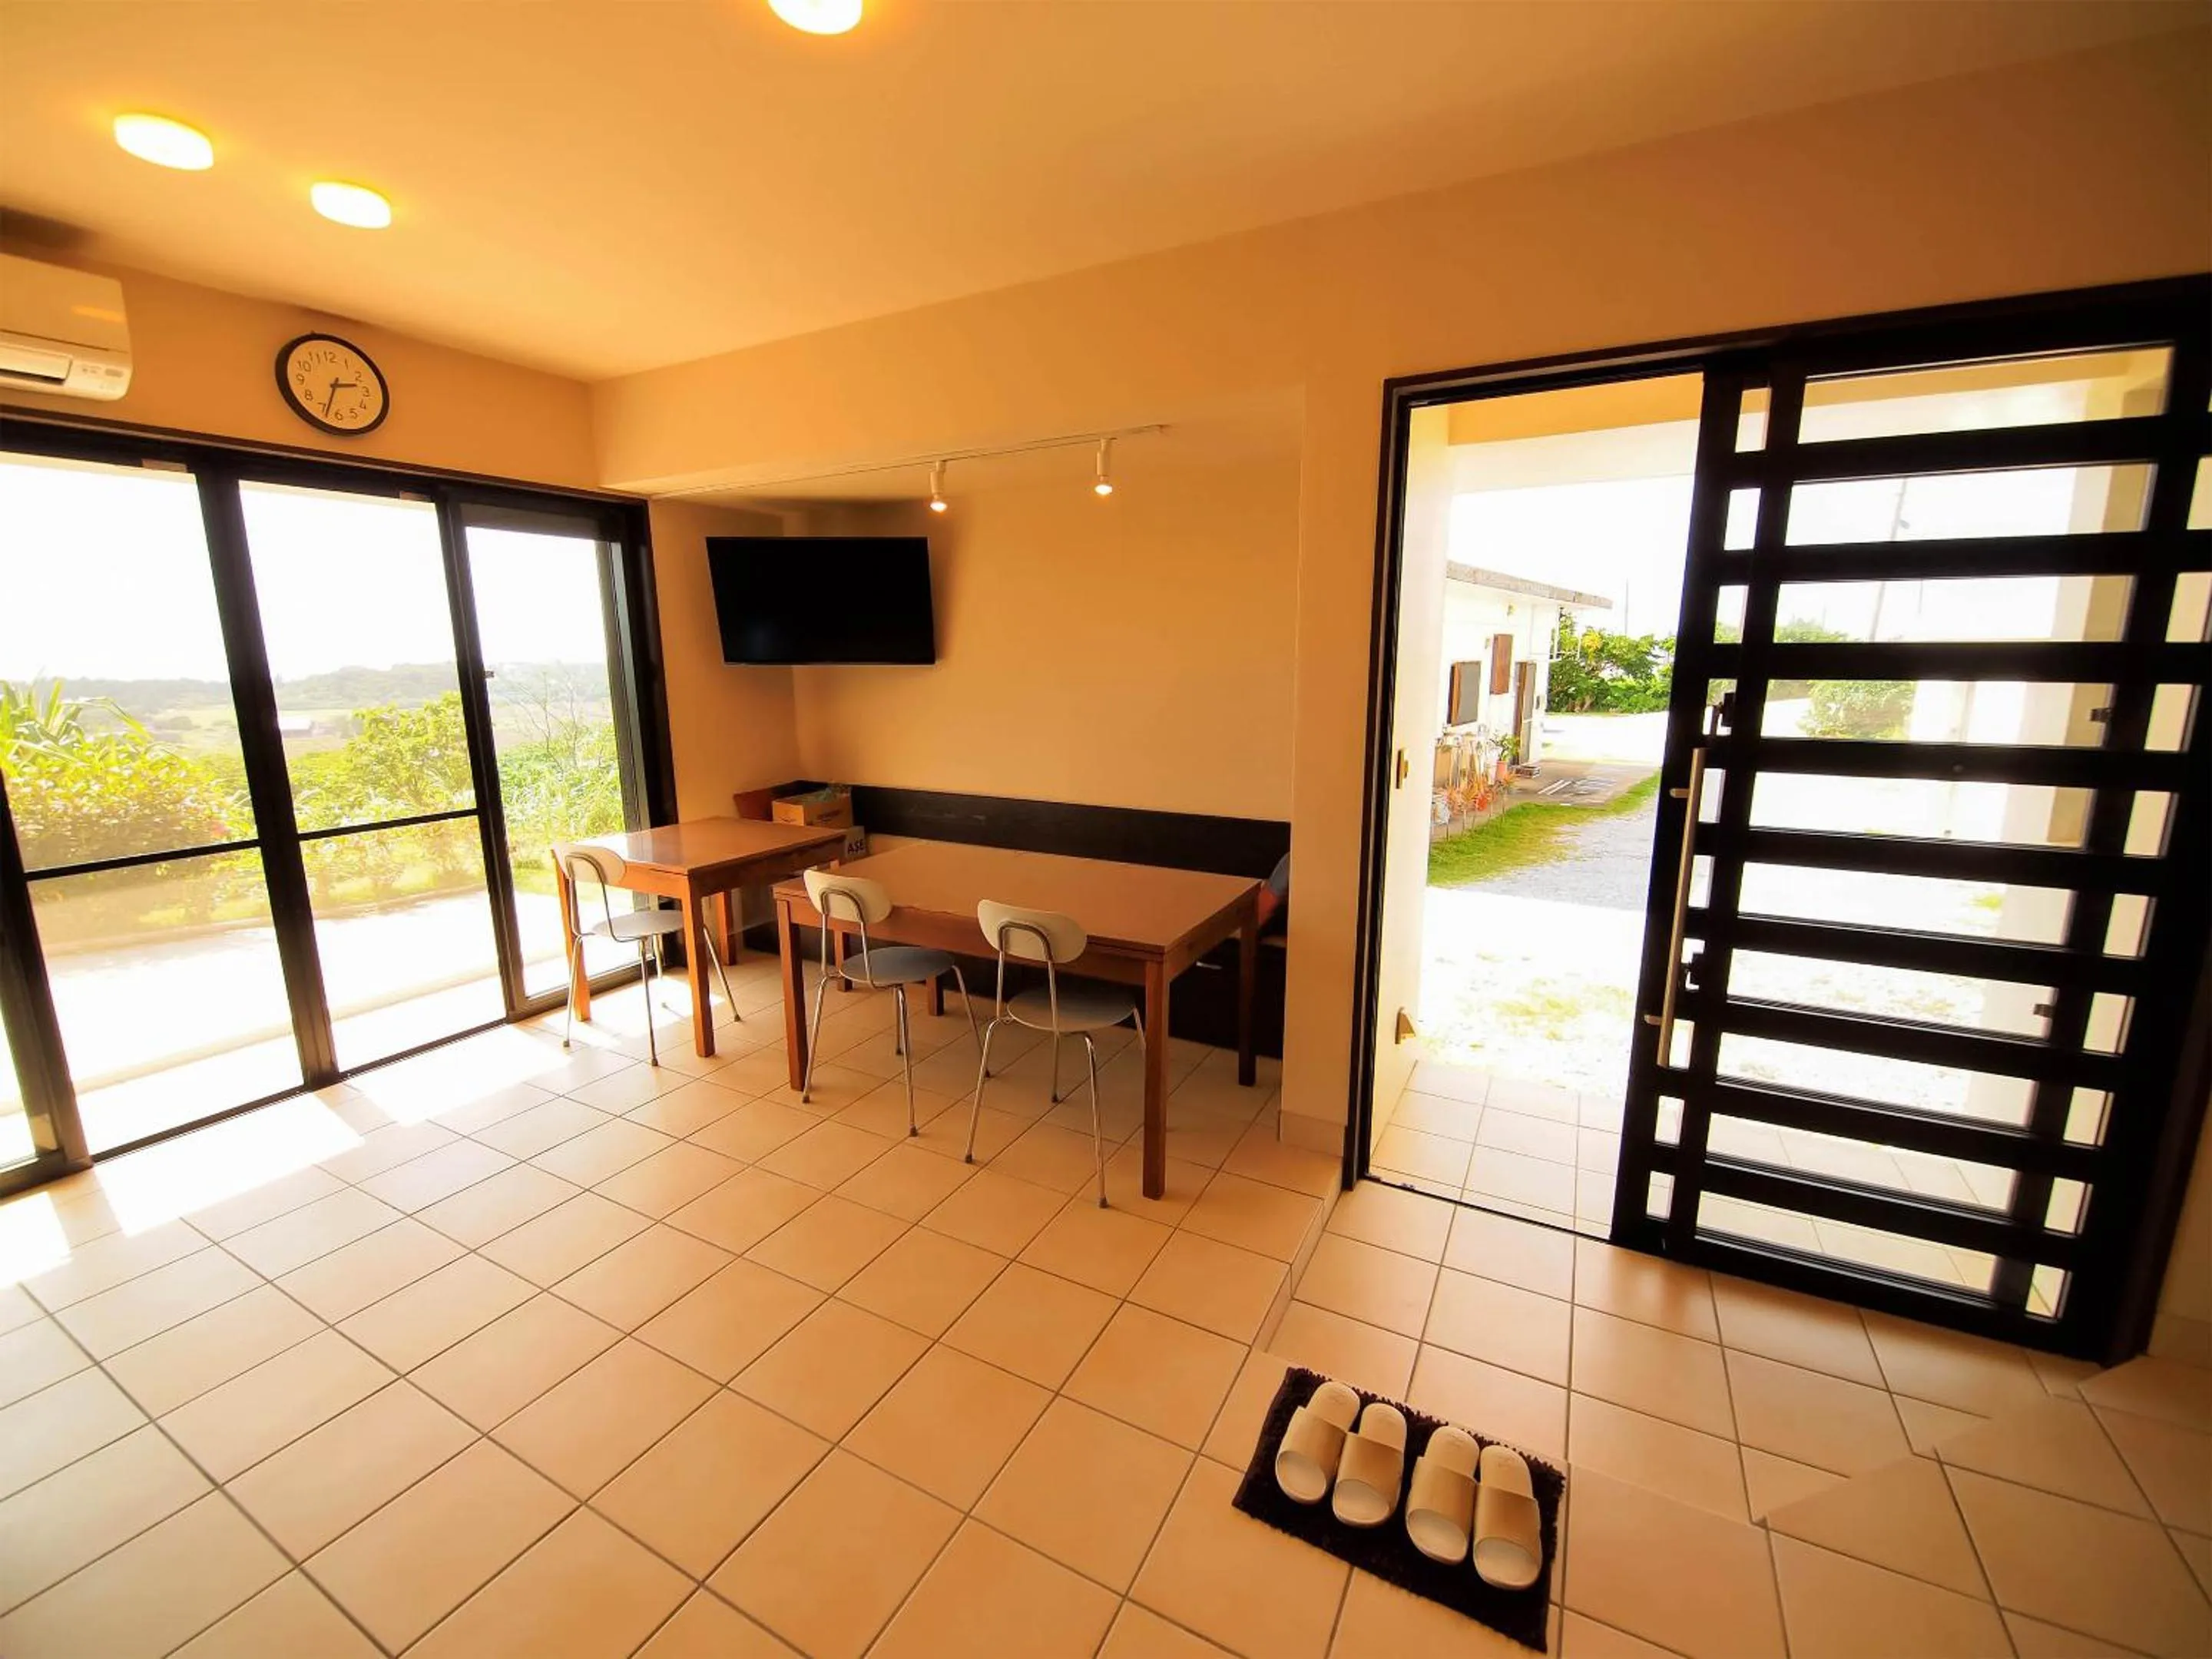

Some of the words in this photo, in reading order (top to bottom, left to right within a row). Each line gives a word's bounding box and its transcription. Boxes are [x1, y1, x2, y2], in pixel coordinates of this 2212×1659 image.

[308, 351, 320, 364] 11
[323, 350, 337, 363] 12
[297, 360, 311, 373] 10
[344, 358, 349, 369] 1
[296, 373, 305, 385] 9
[354, 371, 363, 382] 2
[304, 389, 313, 401] 8
[362, 386, 370, 397] 3
[317, 402, 326, 413] 7
[359, 399, 366, 410] 4
[334, 409, 344, 420] 6
[349, 408, 358, 419] 5
